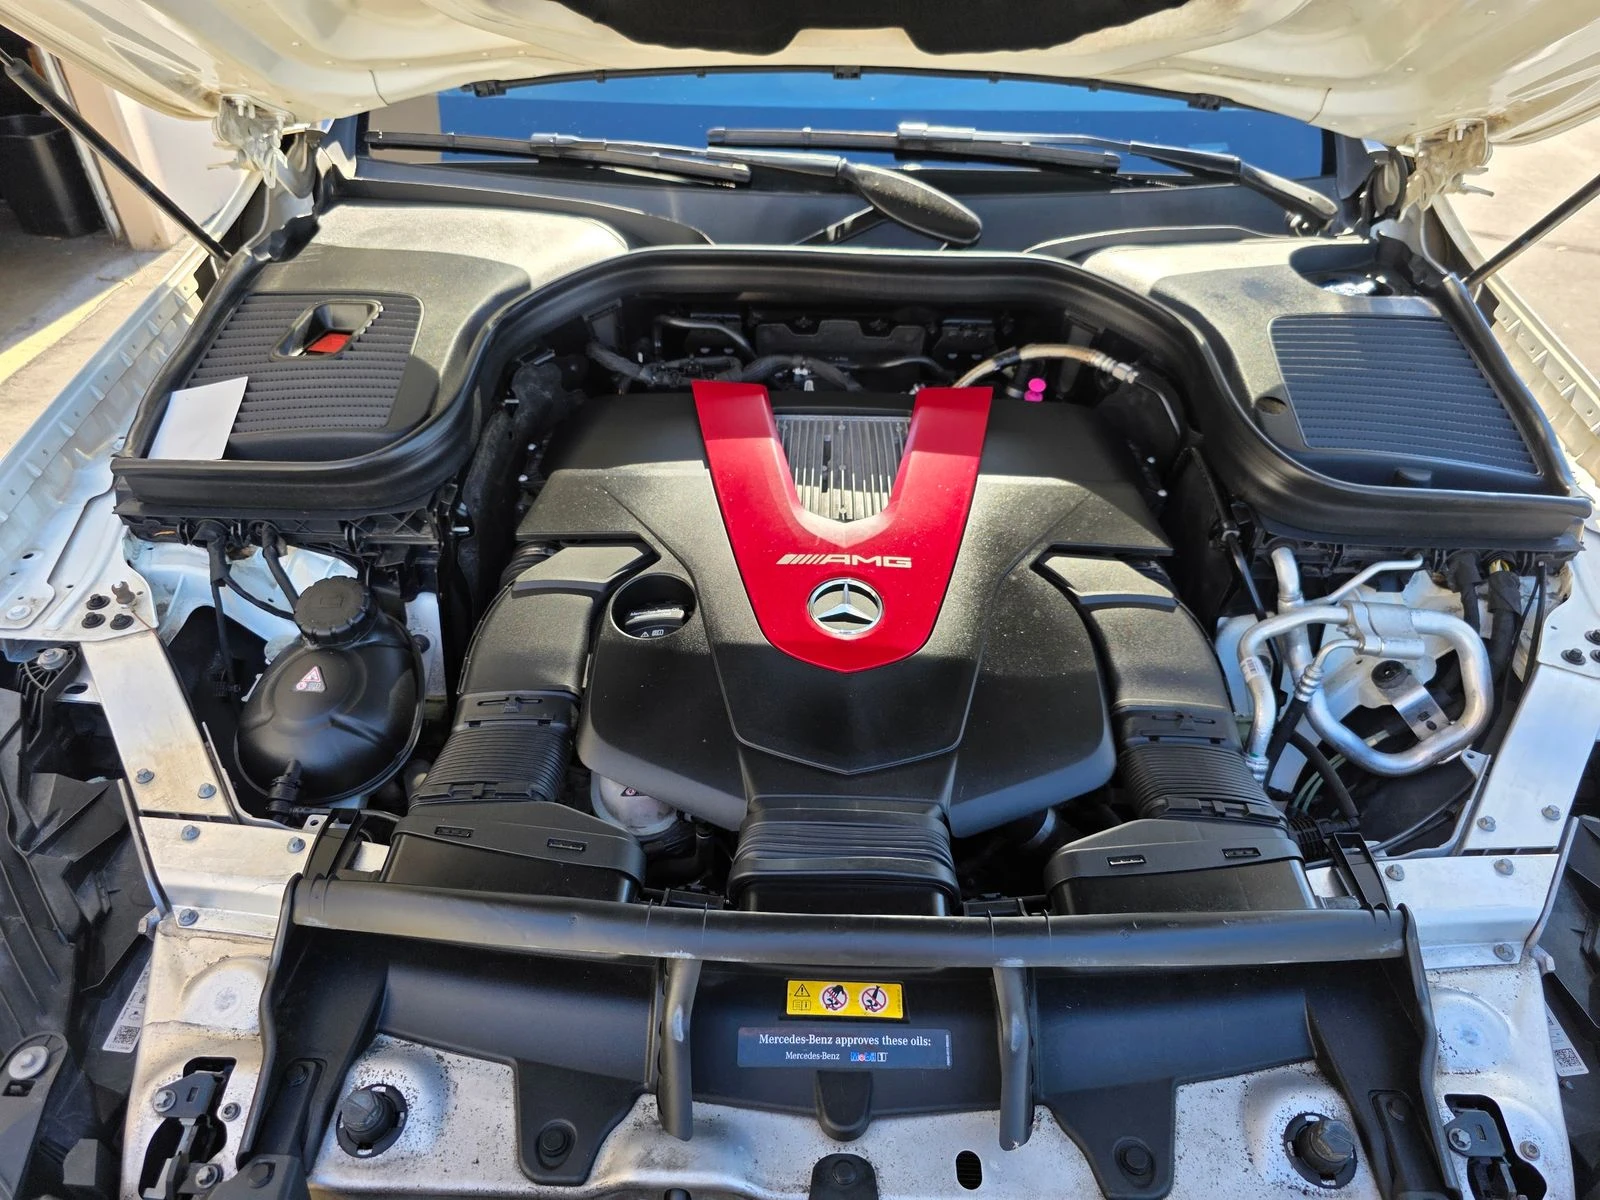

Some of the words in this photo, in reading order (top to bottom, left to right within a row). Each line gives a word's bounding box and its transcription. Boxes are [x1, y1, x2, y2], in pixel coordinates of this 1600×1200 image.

[759, 1034, 833, 1045] Mercedes-Benz
[835, 1036, 880, 1047] approves
[882, 1035, 908, 1046] these
[910, 1036, 931, 1047] oils:
[785, 1051, 840, 1061] Mercedes-Benz
[850, 1051, 877, 1062] Mobil
